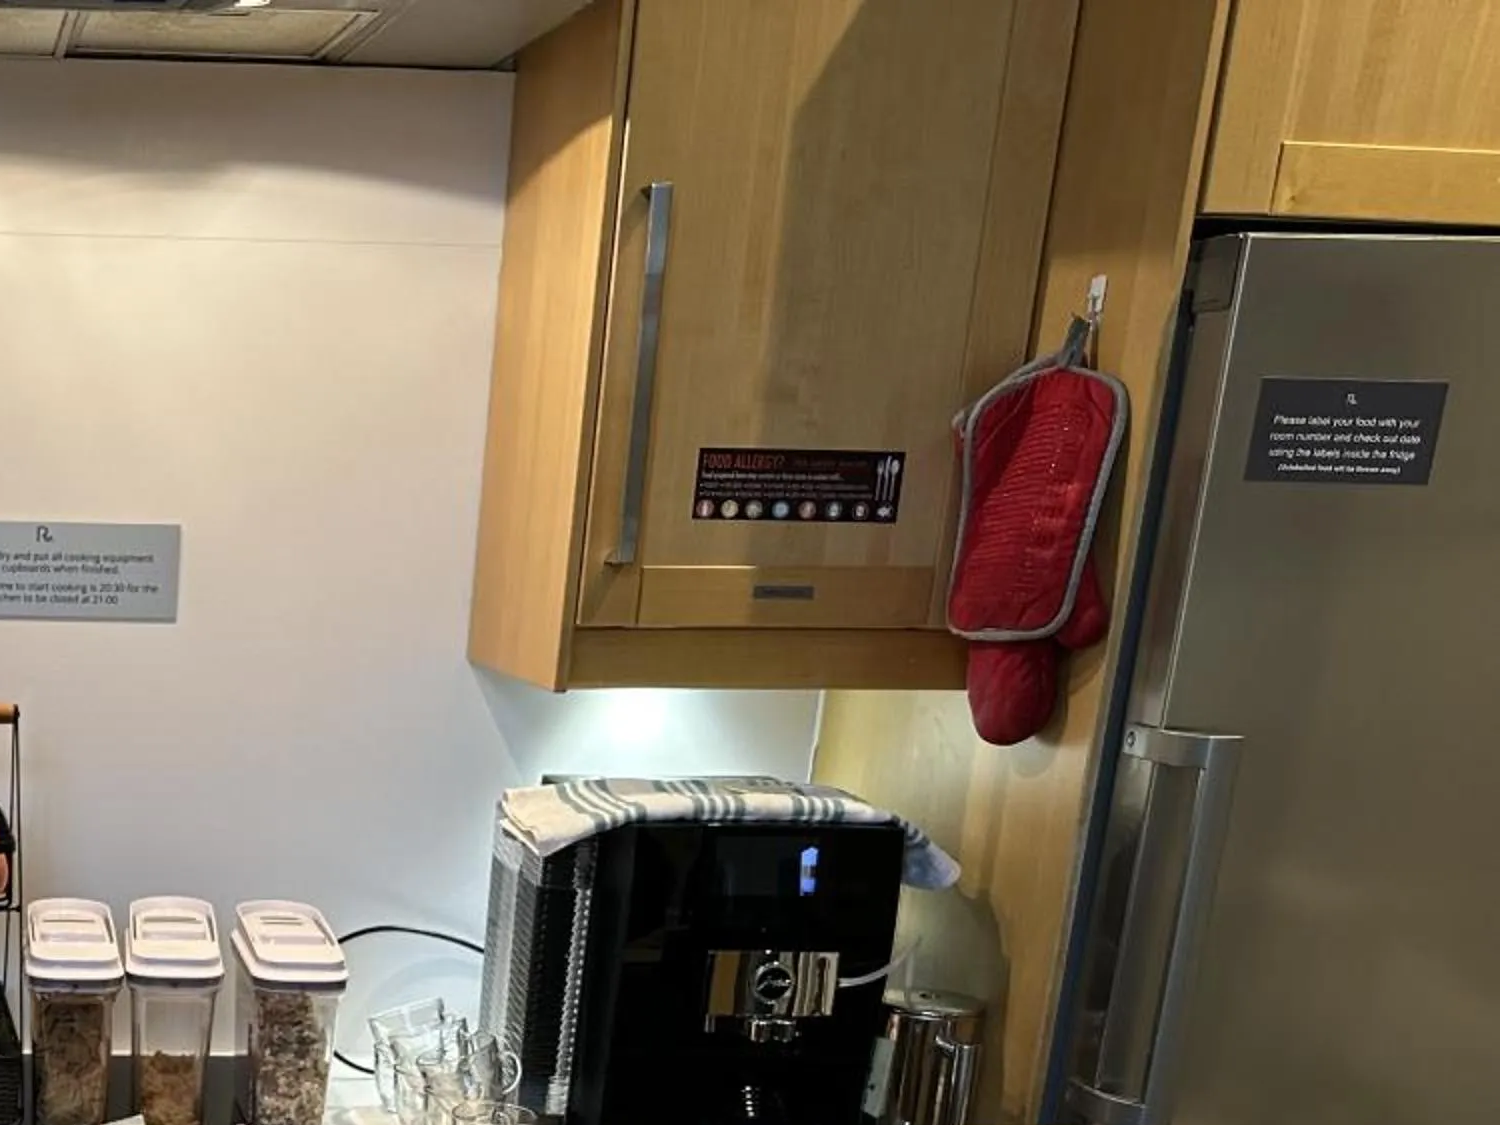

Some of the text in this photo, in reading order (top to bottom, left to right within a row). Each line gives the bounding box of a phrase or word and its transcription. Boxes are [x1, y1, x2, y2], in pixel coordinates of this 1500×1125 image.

[1273, 415, 1420, 429] Please label your food with your
[1269, 433, 1295, 441] room
[1296, 432, 1331, 442] number
[1333, 432, 1351, 443] and
[1353, 432, 1381, 443] check
[1296, 448, 1312, 458] the
[1372, 450, 1387, 460] the
[1389, 450, 1416, 462] fridge
[13, 551, 31, 561] and
[33, 551, 49, 563] put
[51, 551, 62, 561] all
[64, 551, 101, 564] cooking
[2, 563, 51, 574] cupboards
[53, 564, 78, 574] when
[15, 581, 26, 591] to
[28, 581, 50, 592] start
[52, 582, 88, 595] cooking
[89, 583, 98, 593] is
[126, 582, 140, 593] for
[142, 583, 159, 594] the
[35, 593, 48, 603] be
[50, 594, 79, 604] closed
[81, 595, 91, 604] at
